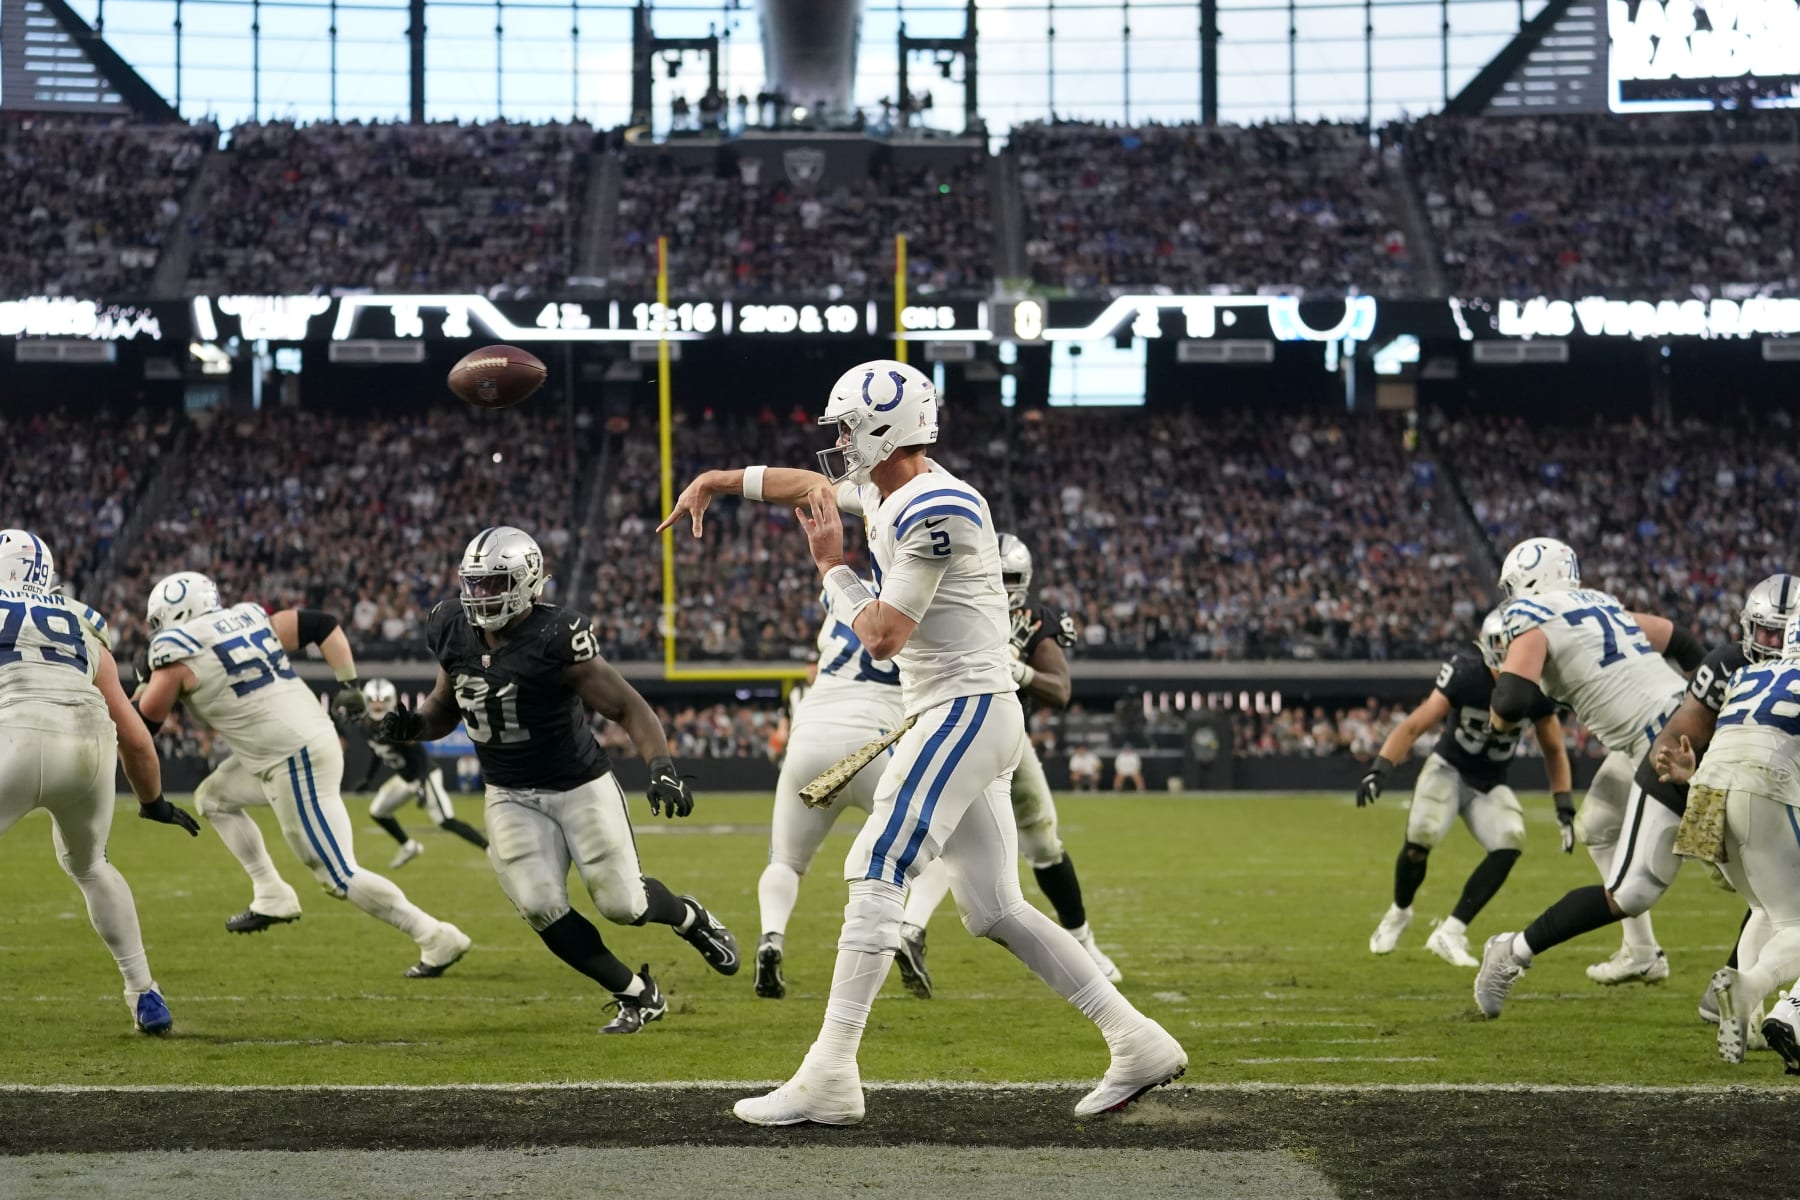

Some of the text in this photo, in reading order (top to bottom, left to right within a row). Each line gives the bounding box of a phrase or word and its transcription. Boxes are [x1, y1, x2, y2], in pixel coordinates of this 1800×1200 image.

[739, 304, 859, 332] 2ND & 10
[1499, 300, 1575, 336] LAS
[931, 530, 952, 556] 2
[22, 558, 49, 587] 79
[1562, 606, 1652, 669] 75
[454, 673, 531, 744] 91
